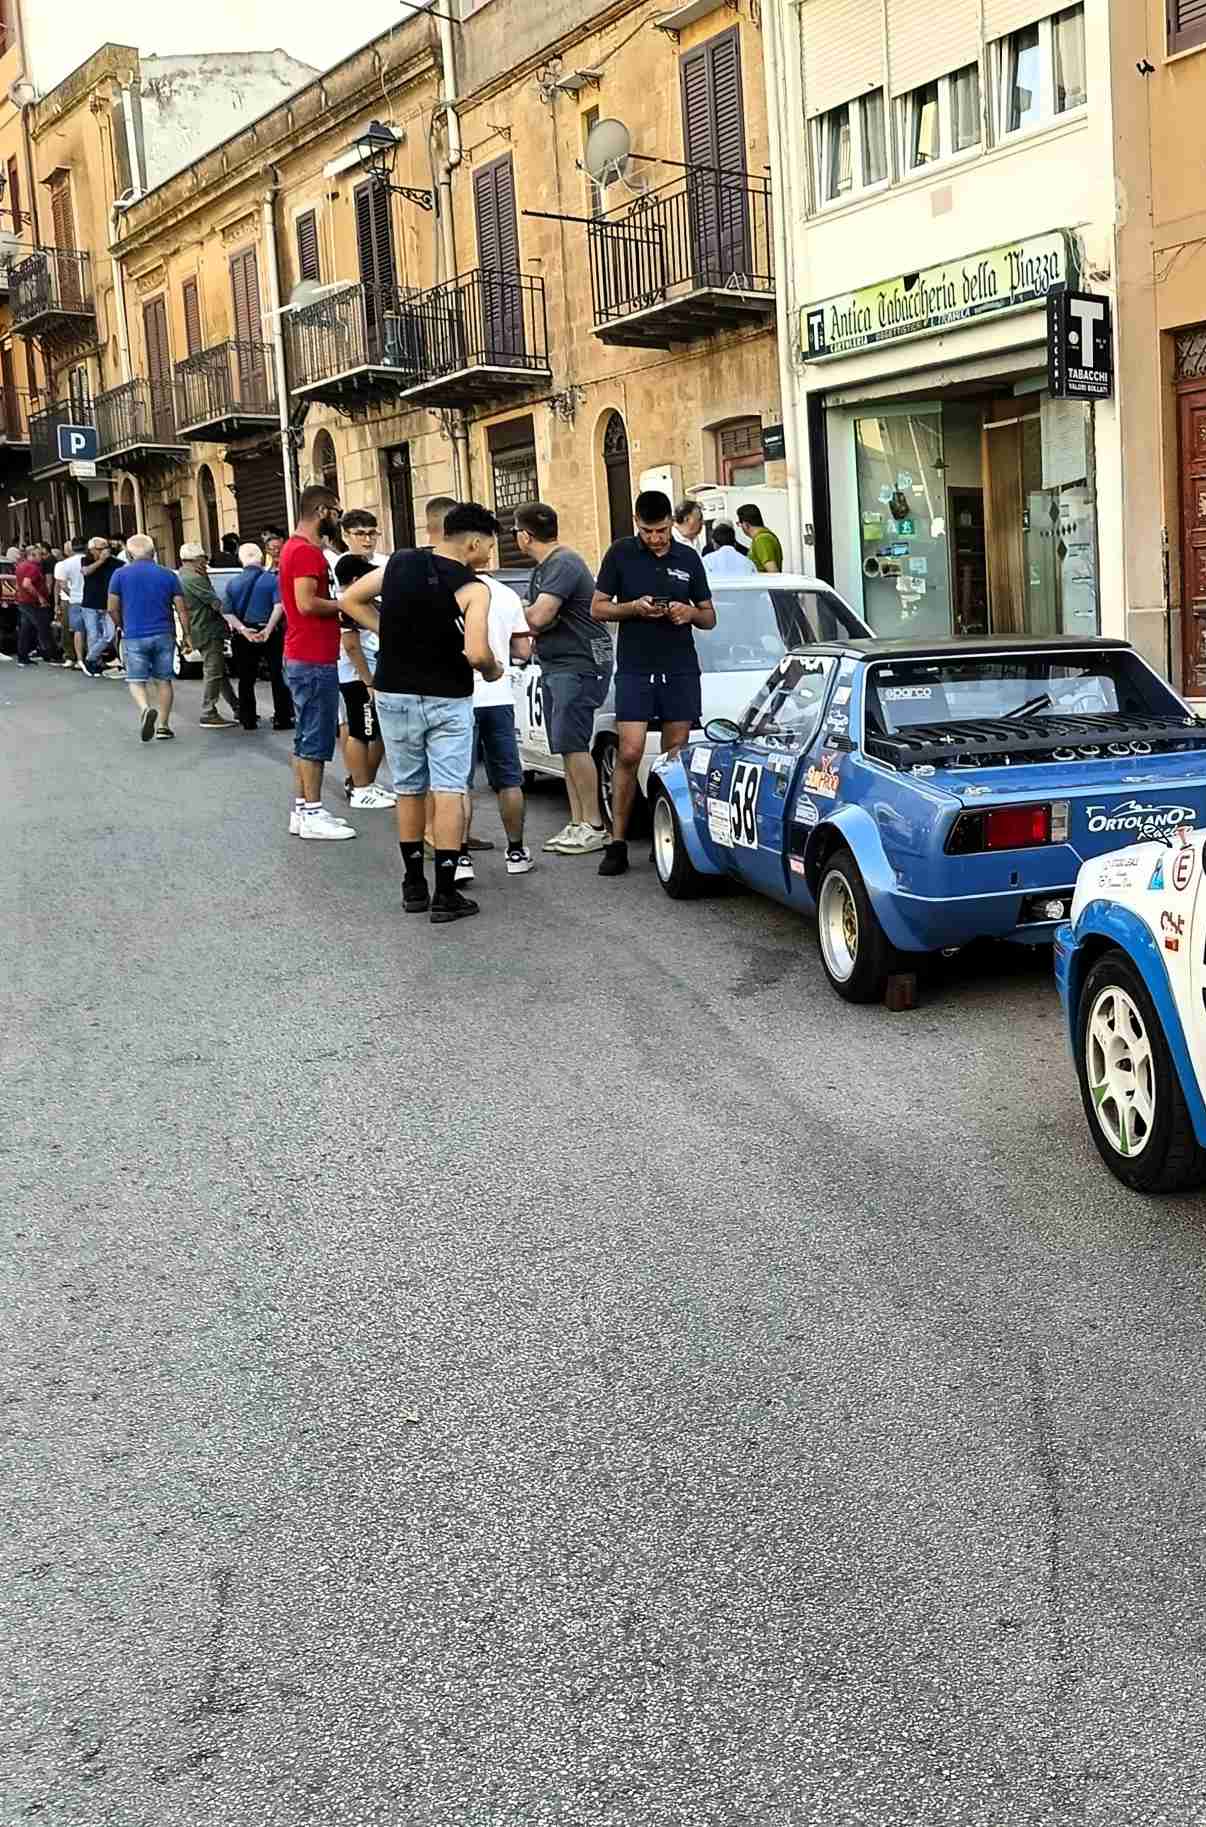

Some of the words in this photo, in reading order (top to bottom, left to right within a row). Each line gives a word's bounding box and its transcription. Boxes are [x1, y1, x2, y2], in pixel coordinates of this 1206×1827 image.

[830, 299, 873, 341] Antica
[876, 271, 959, 328] Tabaccheria
[962, 260, 998, 302] della
[1003, 248, 1061, 305] Piazza
[1070, 298, 1104, 368] T
[1068, 367, 1108, 383] TABACCHI
[1068, 382, 1087, 392] VALORI
[70, 432, 86, 455] P
[526, 675, 543, 727] 15
[731, 765, 759, 846] 58
[1176, 855, 1190, 882] E
